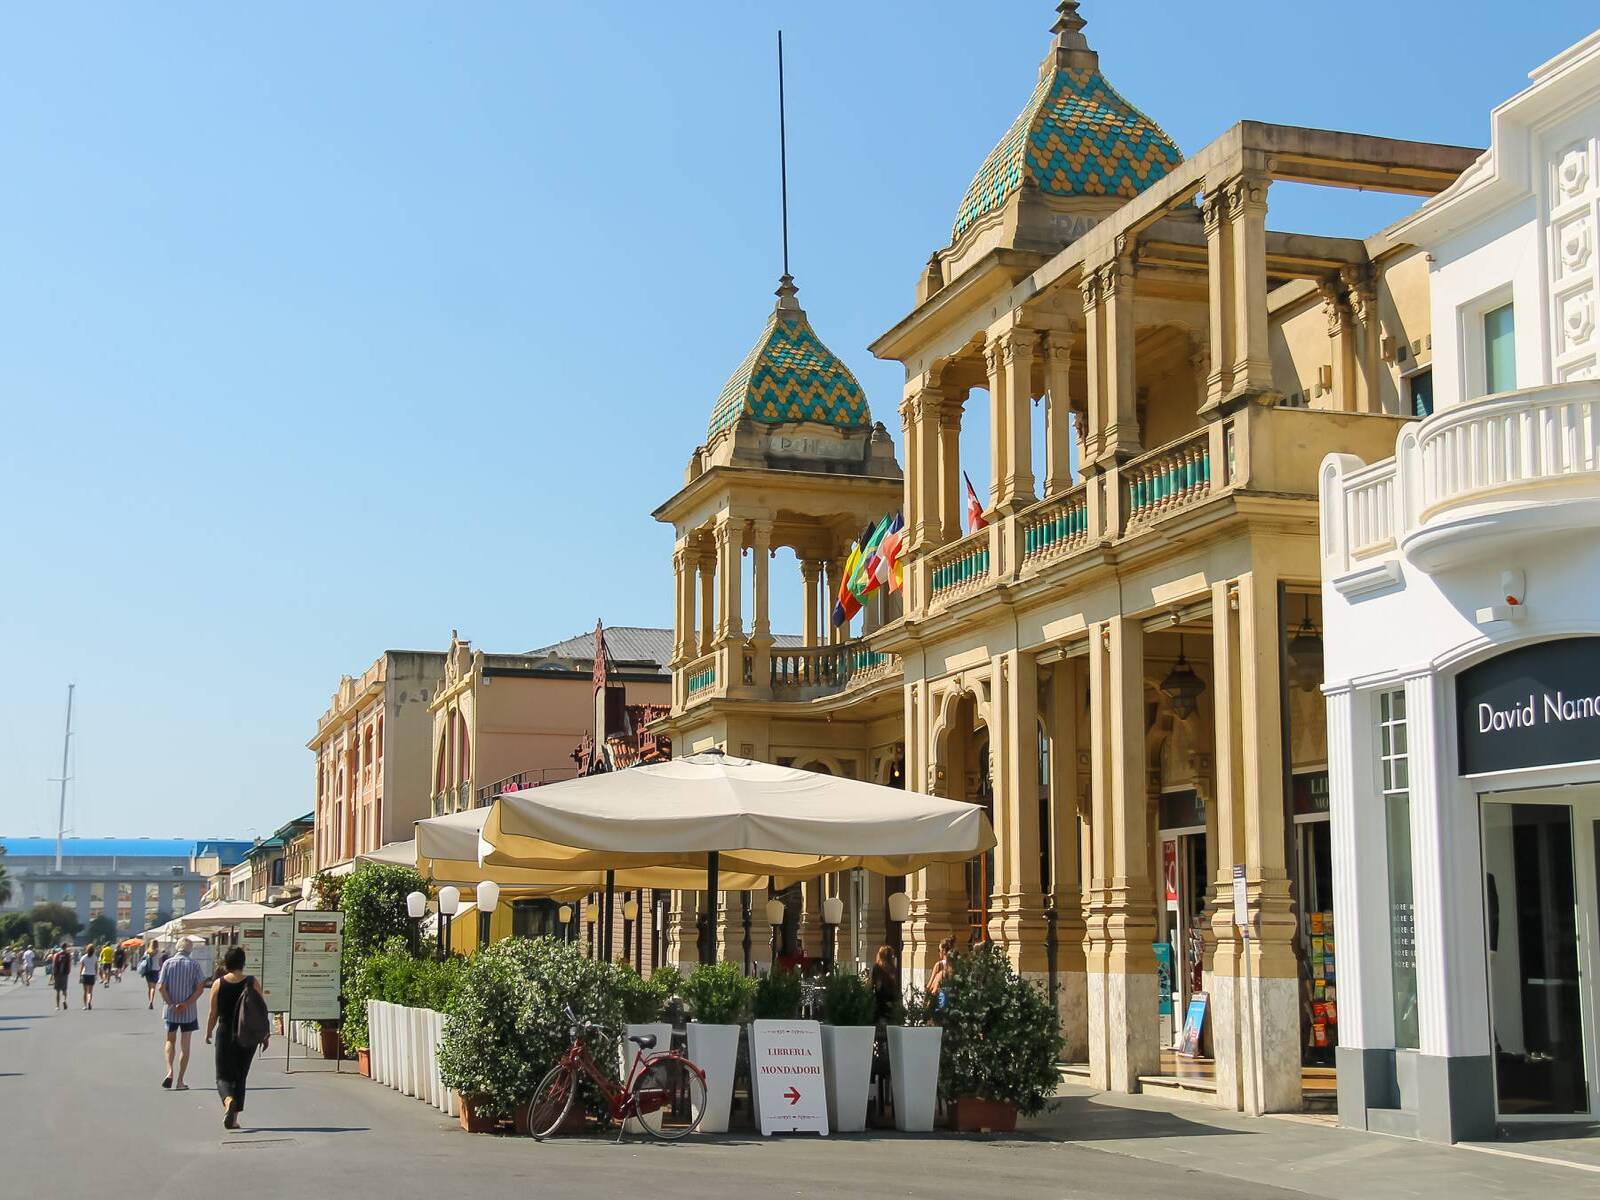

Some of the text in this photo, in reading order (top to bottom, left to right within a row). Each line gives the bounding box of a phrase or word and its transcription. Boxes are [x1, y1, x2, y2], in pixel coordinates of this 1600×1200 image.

[1479, 694, 1534, 733] David
[1392, 926, 1408, 934] RE
[1393, 949, 1409, 957] ORE
[768, 1048, 812, 1056] LIBRERIA
[761, 1065, 820, 1074] MONDADORI
